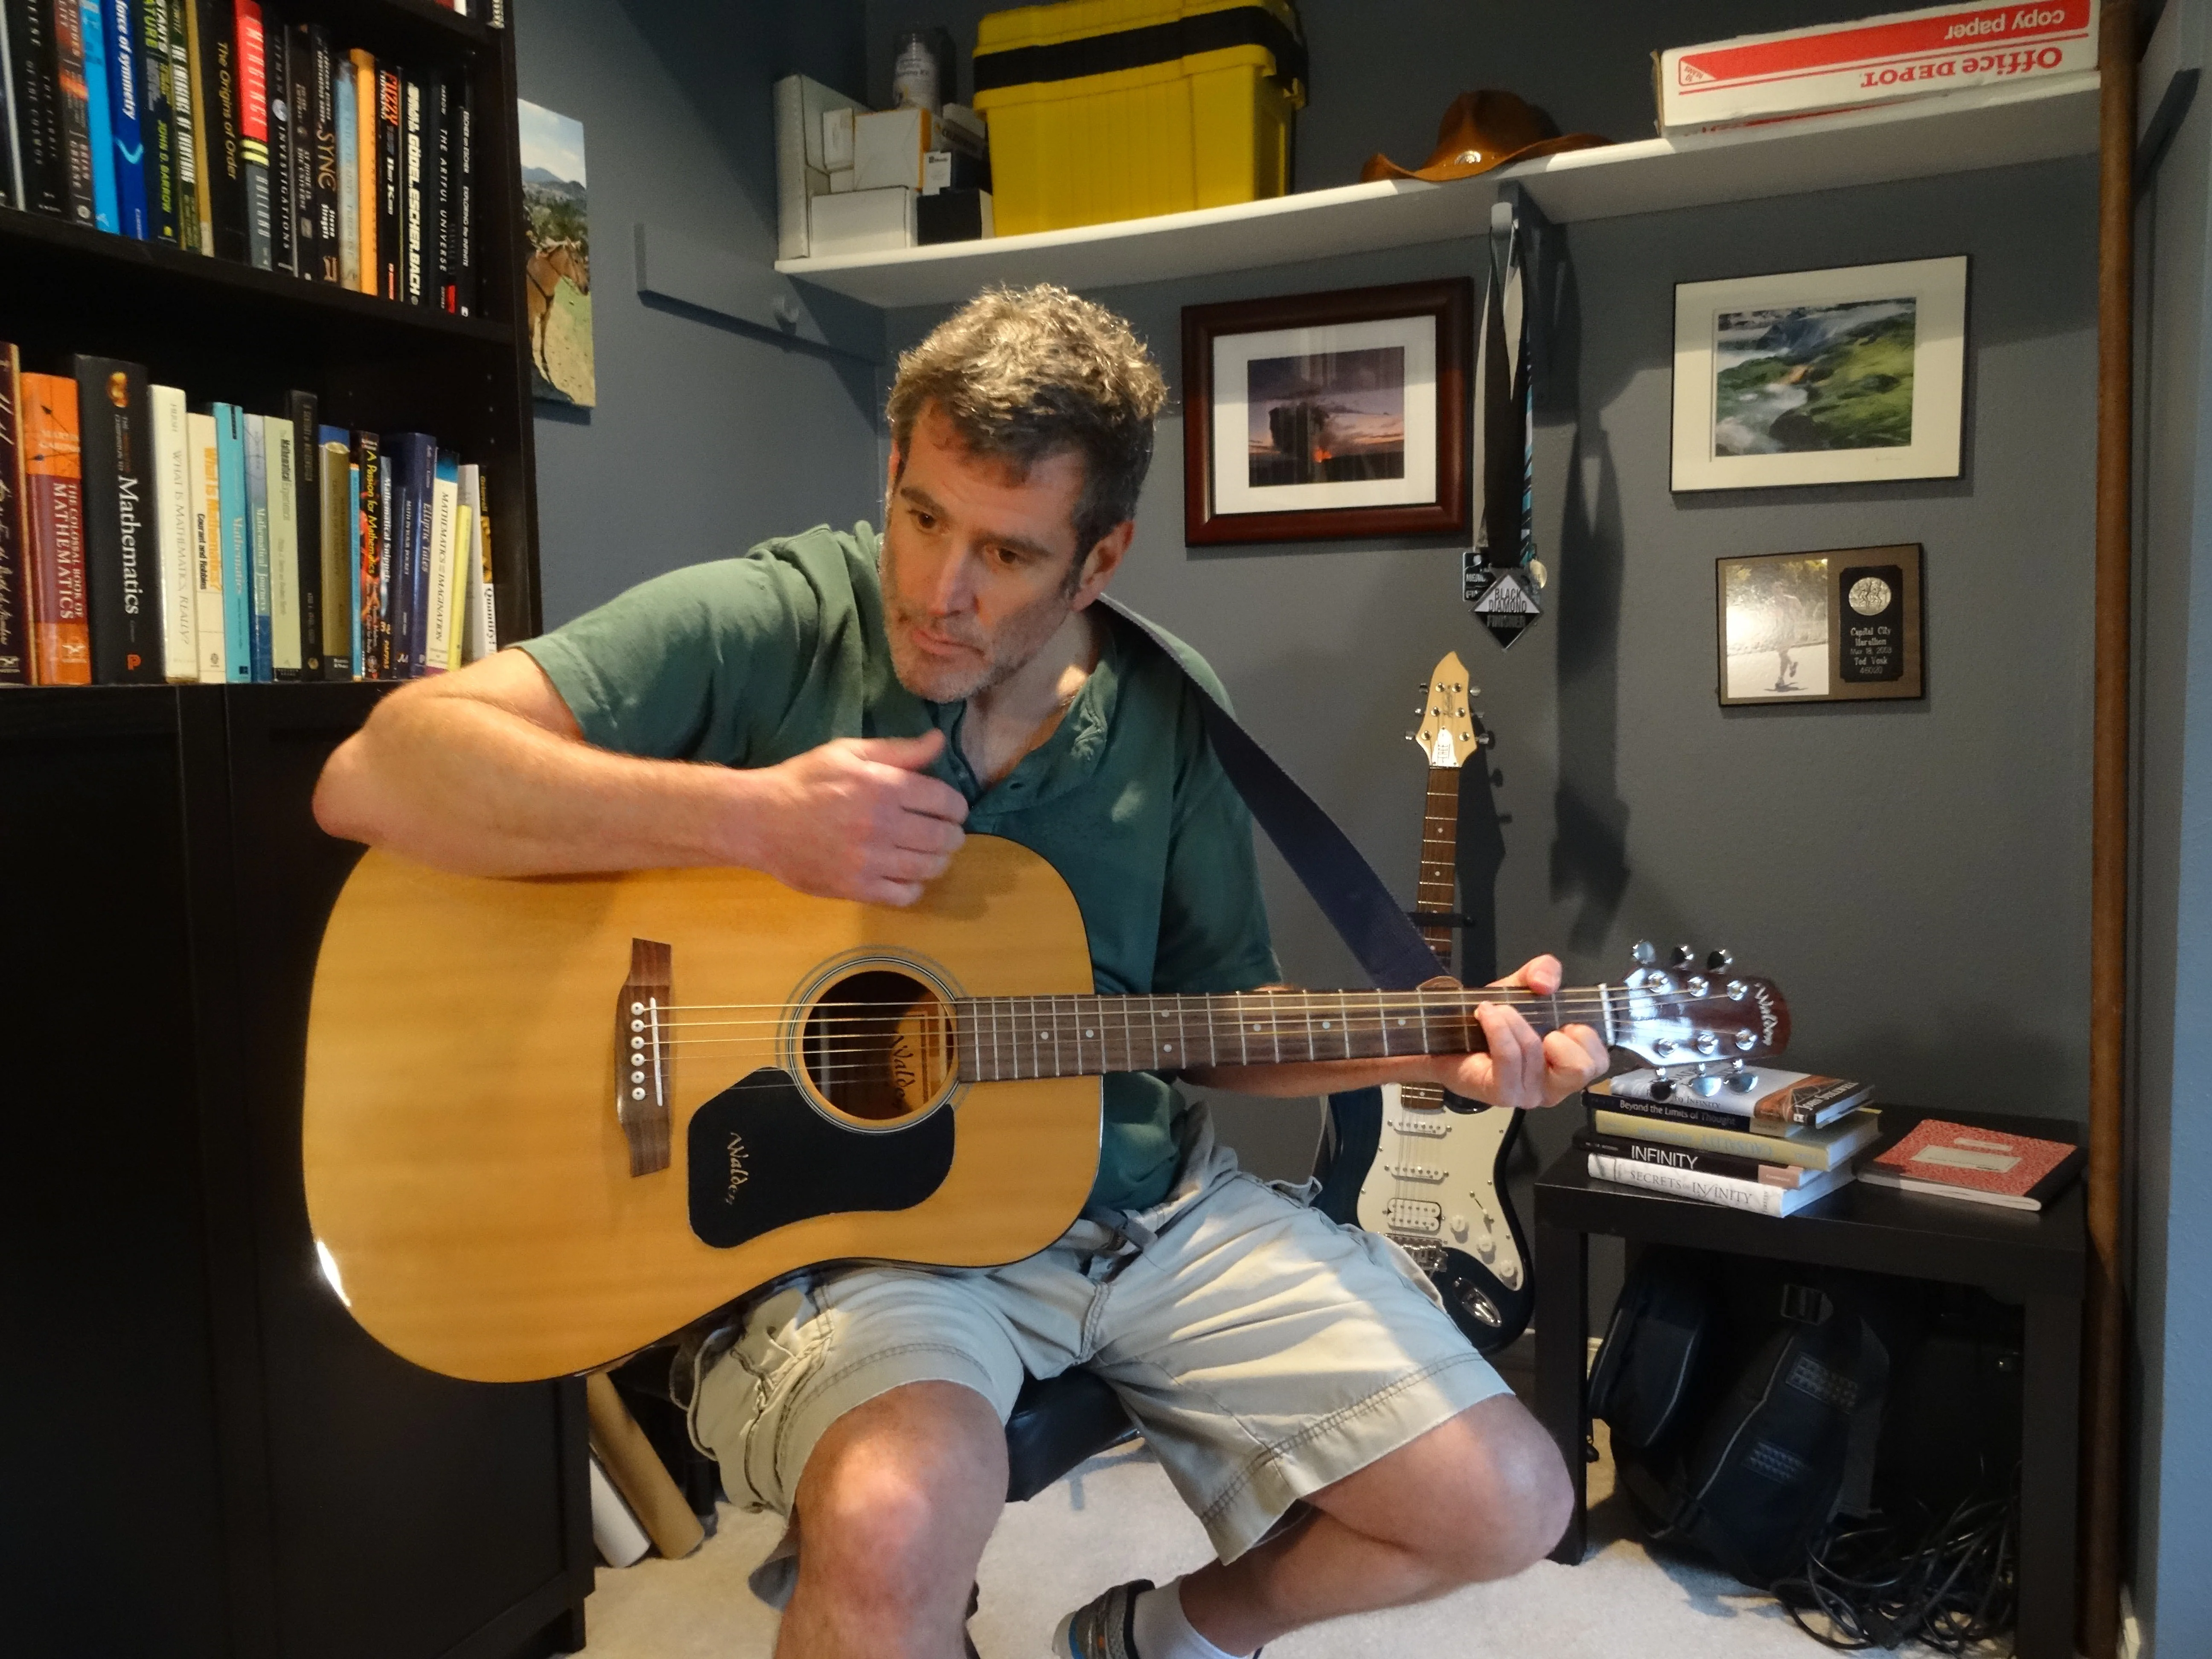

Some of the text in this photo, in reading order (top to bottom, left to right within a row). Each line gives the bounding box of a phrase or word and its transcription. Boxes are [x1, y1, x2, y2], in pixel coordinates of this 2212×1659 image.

[118, 36, 133, 53] of
[1942, 9, 2065, 40] copy paper
[118, 52, 136, 120] symmetry
[1861, 47, 2063, 88] Office DEPOT
[217, 41, 238, 180] The Origins of Order
[385, 73, 399, 127] FUZZY
[278, 125, 291, 249] INVESTIGATIONS
[316, 131, 337, 192] SYNC
[440, 157, 448, 203] ARTFUL
[439, 210, 448, 272] UNIVERSE
[408, 253, 421, 296] BACH
[172, 450, 183, 486] WHAT
[204, 447, 218, 481] What
[366, 464, 377, 497] Passion
[367, 450, 376, 462] A
[174, 492, 184, 501] IS
[367, 500, 377, 513] for
[52, 482, 75, 619] MATHEMATICS
[68, 484, 84, 618] THE COLOSSAL BOOK OF
[117, 474, 143, 614] Mathematics
[197, 513, 207, 543] Courant
[207, 498, 223, 592] Mathematics?
[232, 515, 244, 595] Mathematics
[256, 507, 268, 568] Mathematical
[367, 515, 379, 574] Mathematics
[382, 478, 392, 583] Mathematical Snippets
[420, 501, 432, 572] Elliptic Tales
[438, 492, 449, 564] MATHEMATICS
[178, 595, 190, 645] REALLY?
[435, 573, 447, 642] IMAGINATION
[484, 588, 496, 646] Quantify!
[1488, 599, 1527, 613] DIAMOND
[1494, 588, 1521, 601] BLACK
[1877, 626, 1892, 635] City
[892, 1031, 916, 1099] Walde
[1620, 1099, 1648, 1112] Beyond
[1650, 1104, 1663, 1115] the
[1665, 1106, 1688, 1118] Limits
[1689, 1111, 1700, 1120] of
[726, 1132, 749, 1206] Walden
[1630, 1170, 1682, 1190] SECRETS
[1631, 1144, 1699, 1170] INFINITY
